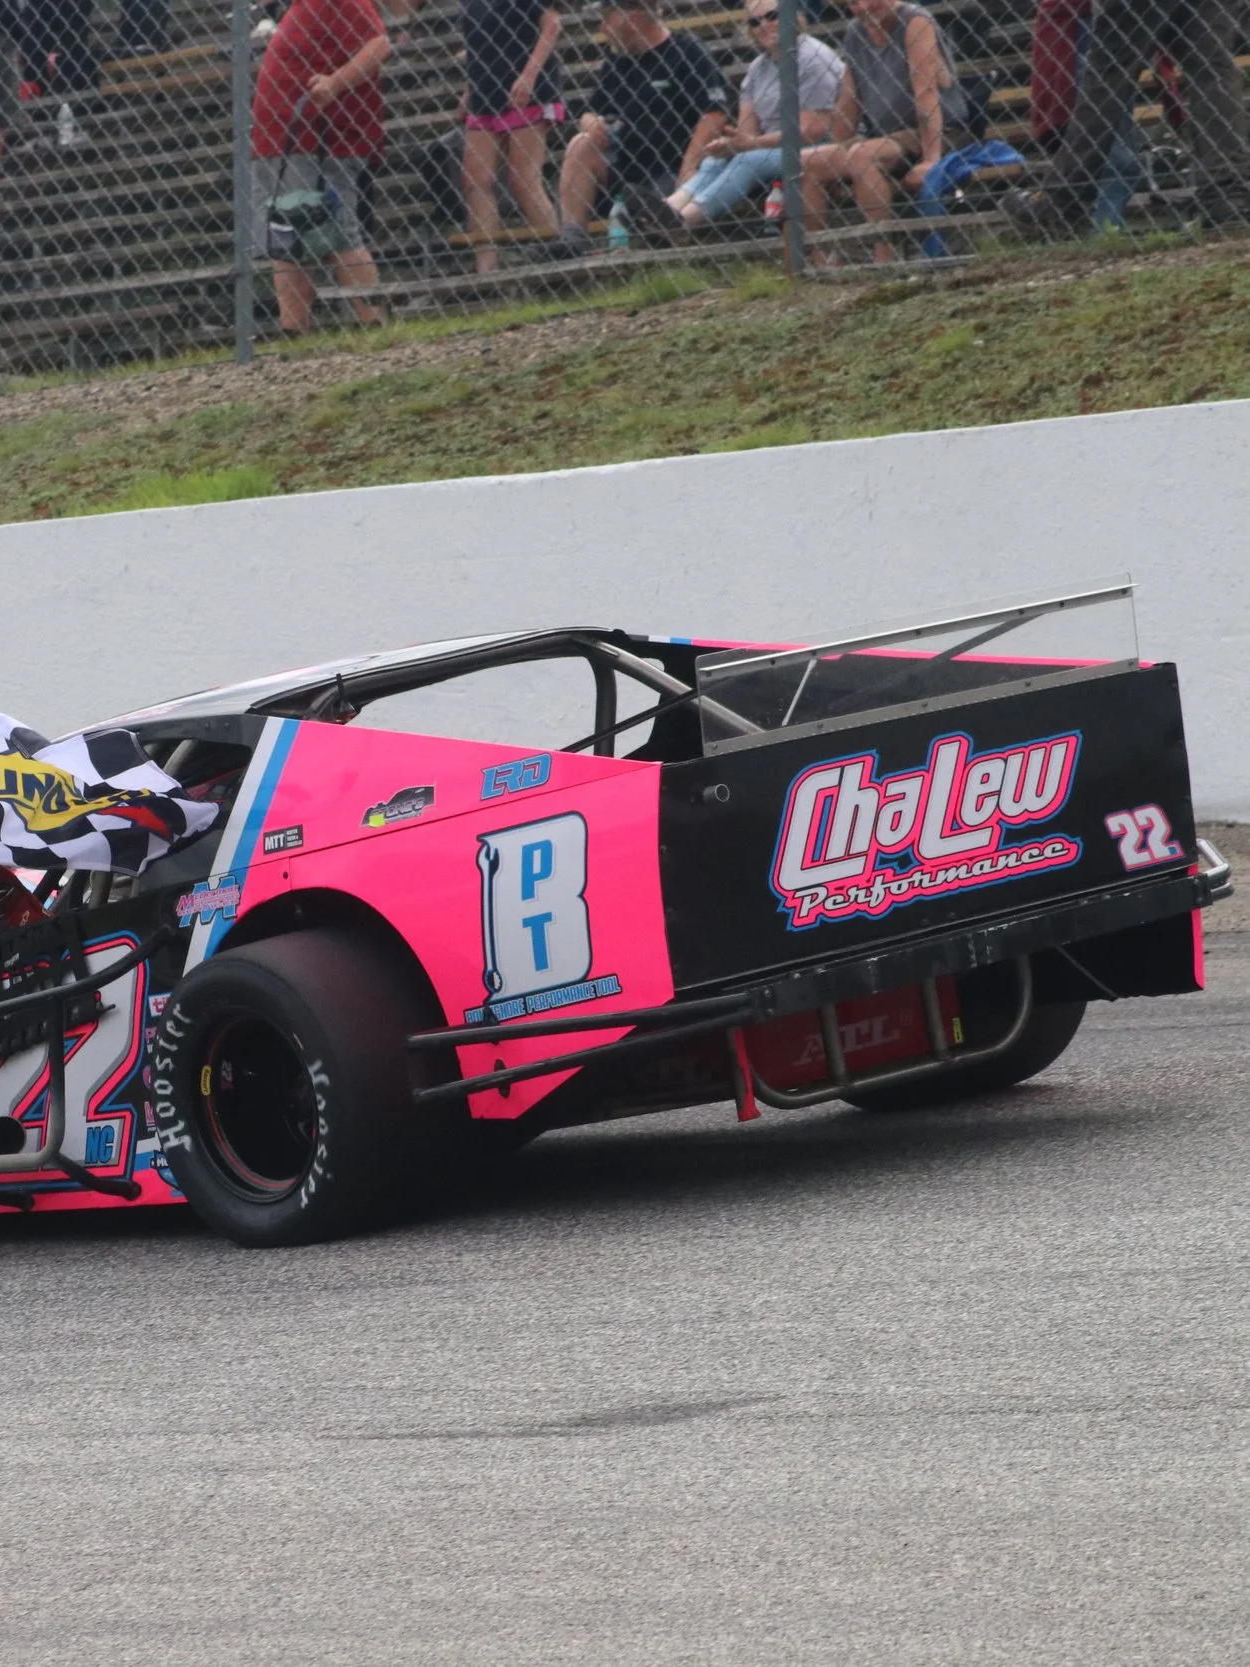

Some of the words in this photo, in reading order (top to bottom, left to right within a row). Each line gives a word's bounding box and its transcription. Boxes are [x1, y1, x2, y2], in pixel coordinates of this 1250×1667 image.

[264, 833, 285, 851] MTT
[777, 738, 1075, 891] ChaLew
[1105, 804, 1184, 870] 22
[521, 839, 554, 901] P
[794, 842, 1072, 918] Performance
[521, 911, 553, 972] T
[526, 982, 595, 1014] PERFORMANCE
[595, 975, 622, 996] TOOL
[85, 1125, 115, 1165] NC
